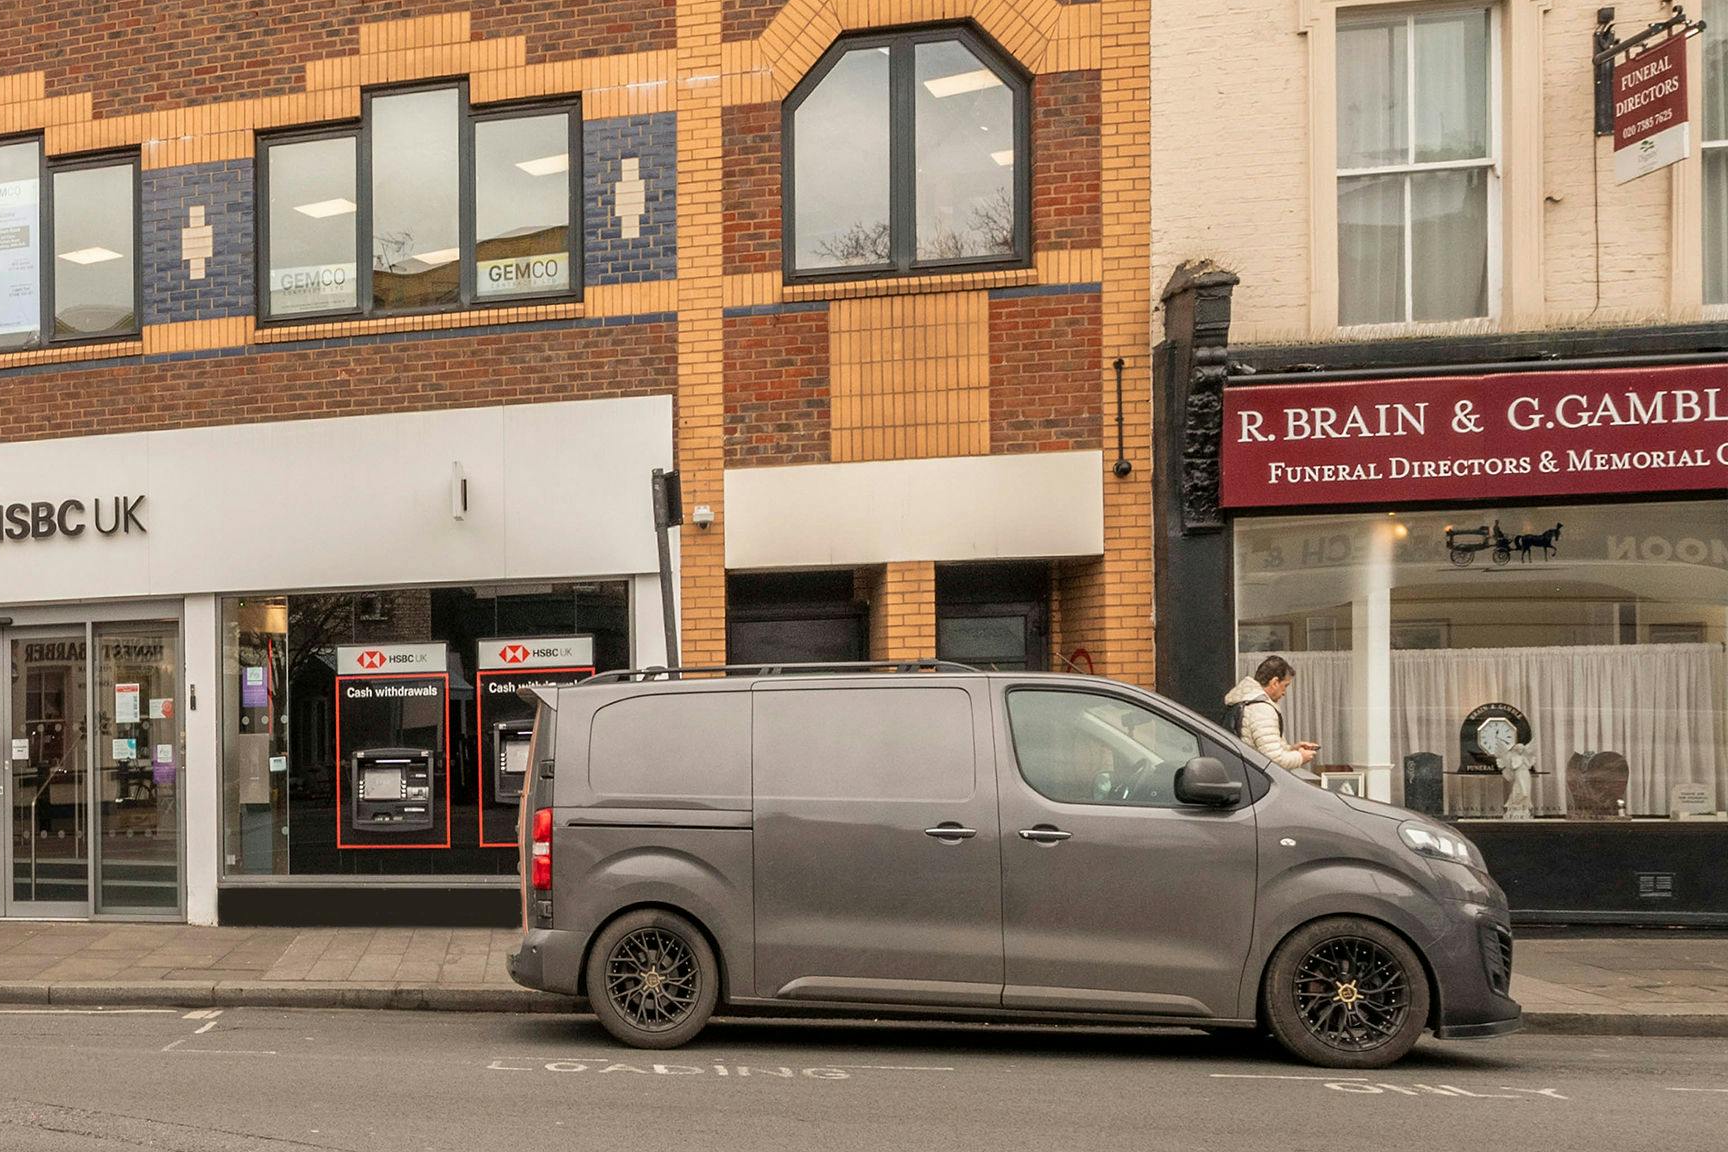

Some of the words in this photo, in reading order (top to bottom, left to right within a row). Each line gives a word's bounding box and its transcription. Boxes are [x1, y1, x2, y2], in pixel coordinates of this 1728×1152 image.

[1621, 55, 1672, 91] FUNERAL
[1615, 76, 1680, 117] DIRECTORS
[280, 266, 346, 291] GEMCO
[488, 258, 559, 282] GEMCO
[1450, 399, 1484, 434] &
[1268, 460, 1383, 485] FUNERAL
[1388, 455, 1532, 480] DIRECTORS
[1538, 450, 1560, 474] &
[1566, 447, 1712, 473] MEMORIAL
[94, 494, 147, 535] UK
[388, 653, 414, 664] HSBC
[415, 653, 428, 663] UK
[532, 647, 559, 658] HSBC
[560, 647, 573, 657] UK
[346, 686, 373, 698] Cash
[375, 684, 438, 697] withdrawals
[488, 681, 515, 694] Cash
[485, 1059, 853, 1080] LOADING
[1323, 1081, 1569, 1099] ONLY
